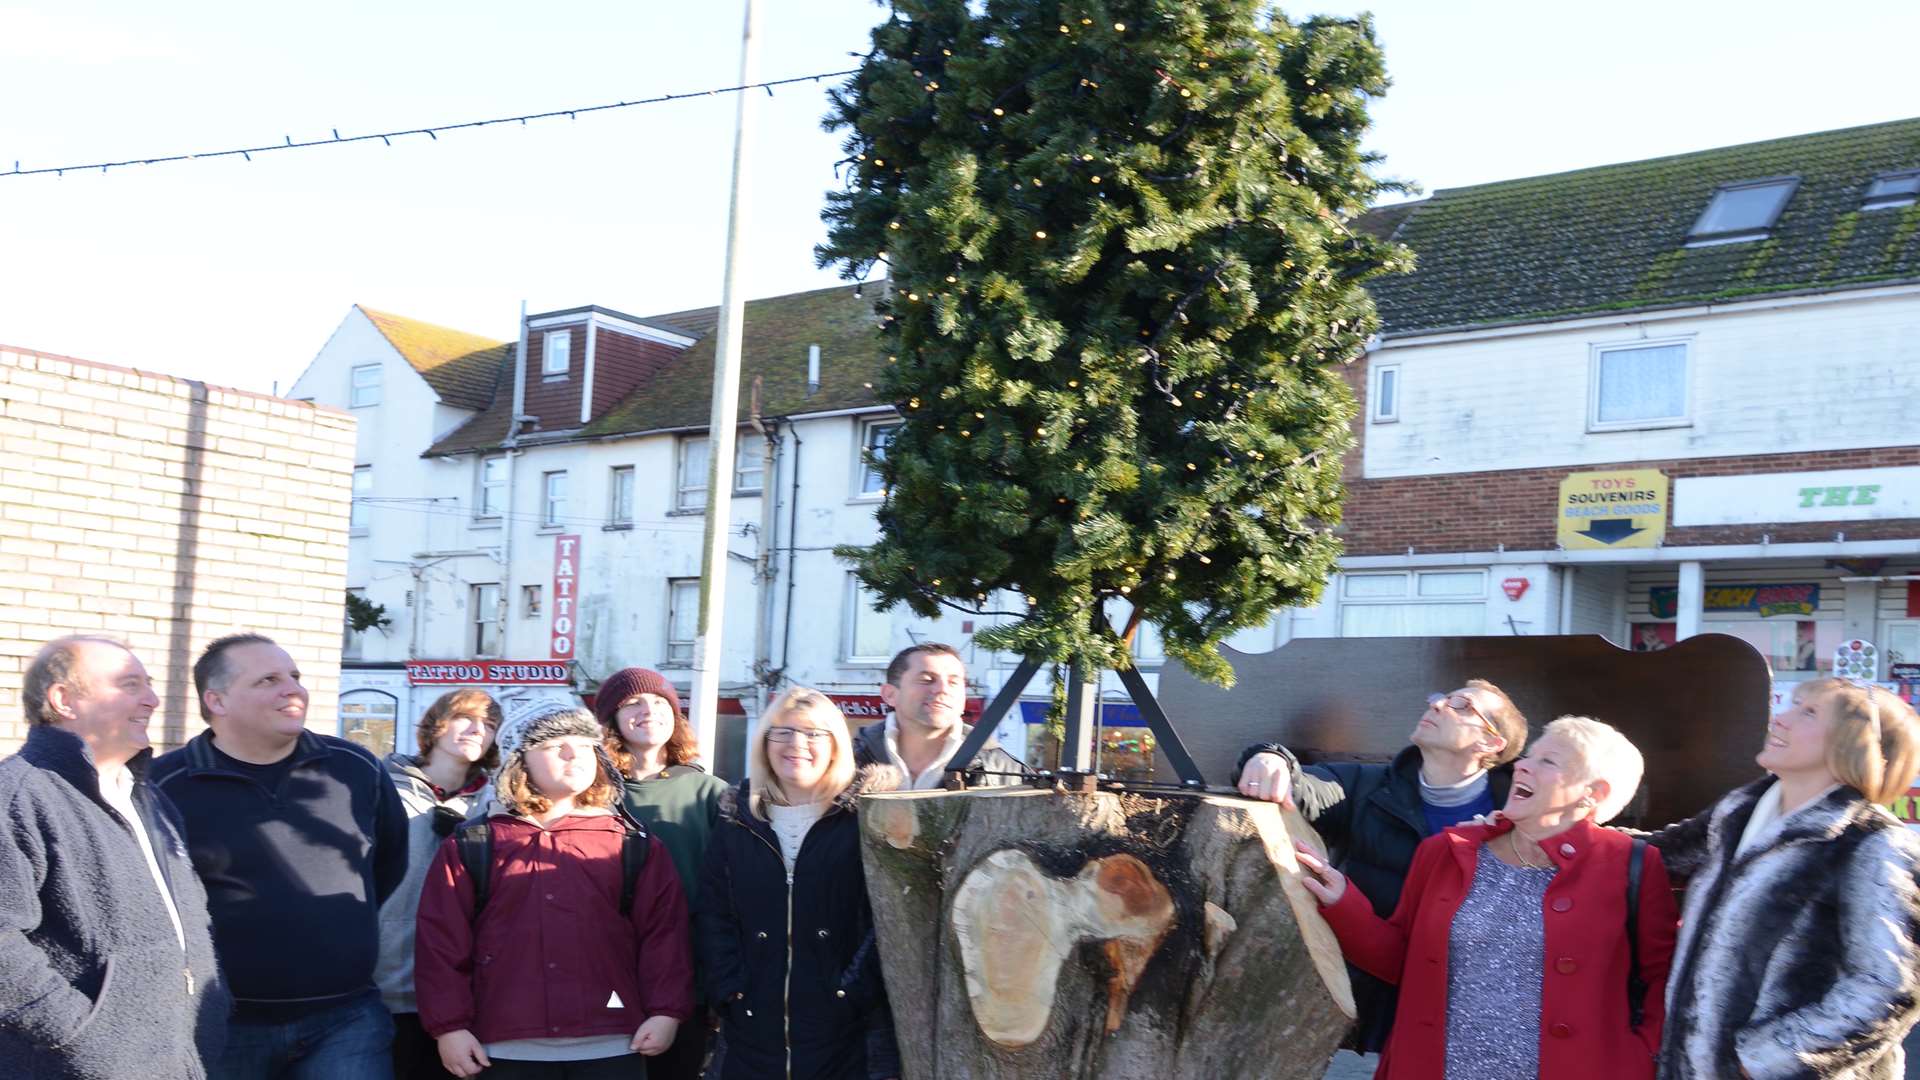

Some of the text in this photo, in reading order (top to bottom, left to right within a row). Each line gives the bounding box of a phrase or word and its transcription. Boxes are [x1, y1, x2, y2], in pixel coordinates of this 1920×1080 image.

[1592, 478, 1636, 489] TOYS
[1568, 490, 1656, 504] SOUVENIRS
[1798, 485, 1880, 508] THE
[553, 539, 576, 655] TATTOO
[408, 665, 568, 680] TATTOO STUDIO
